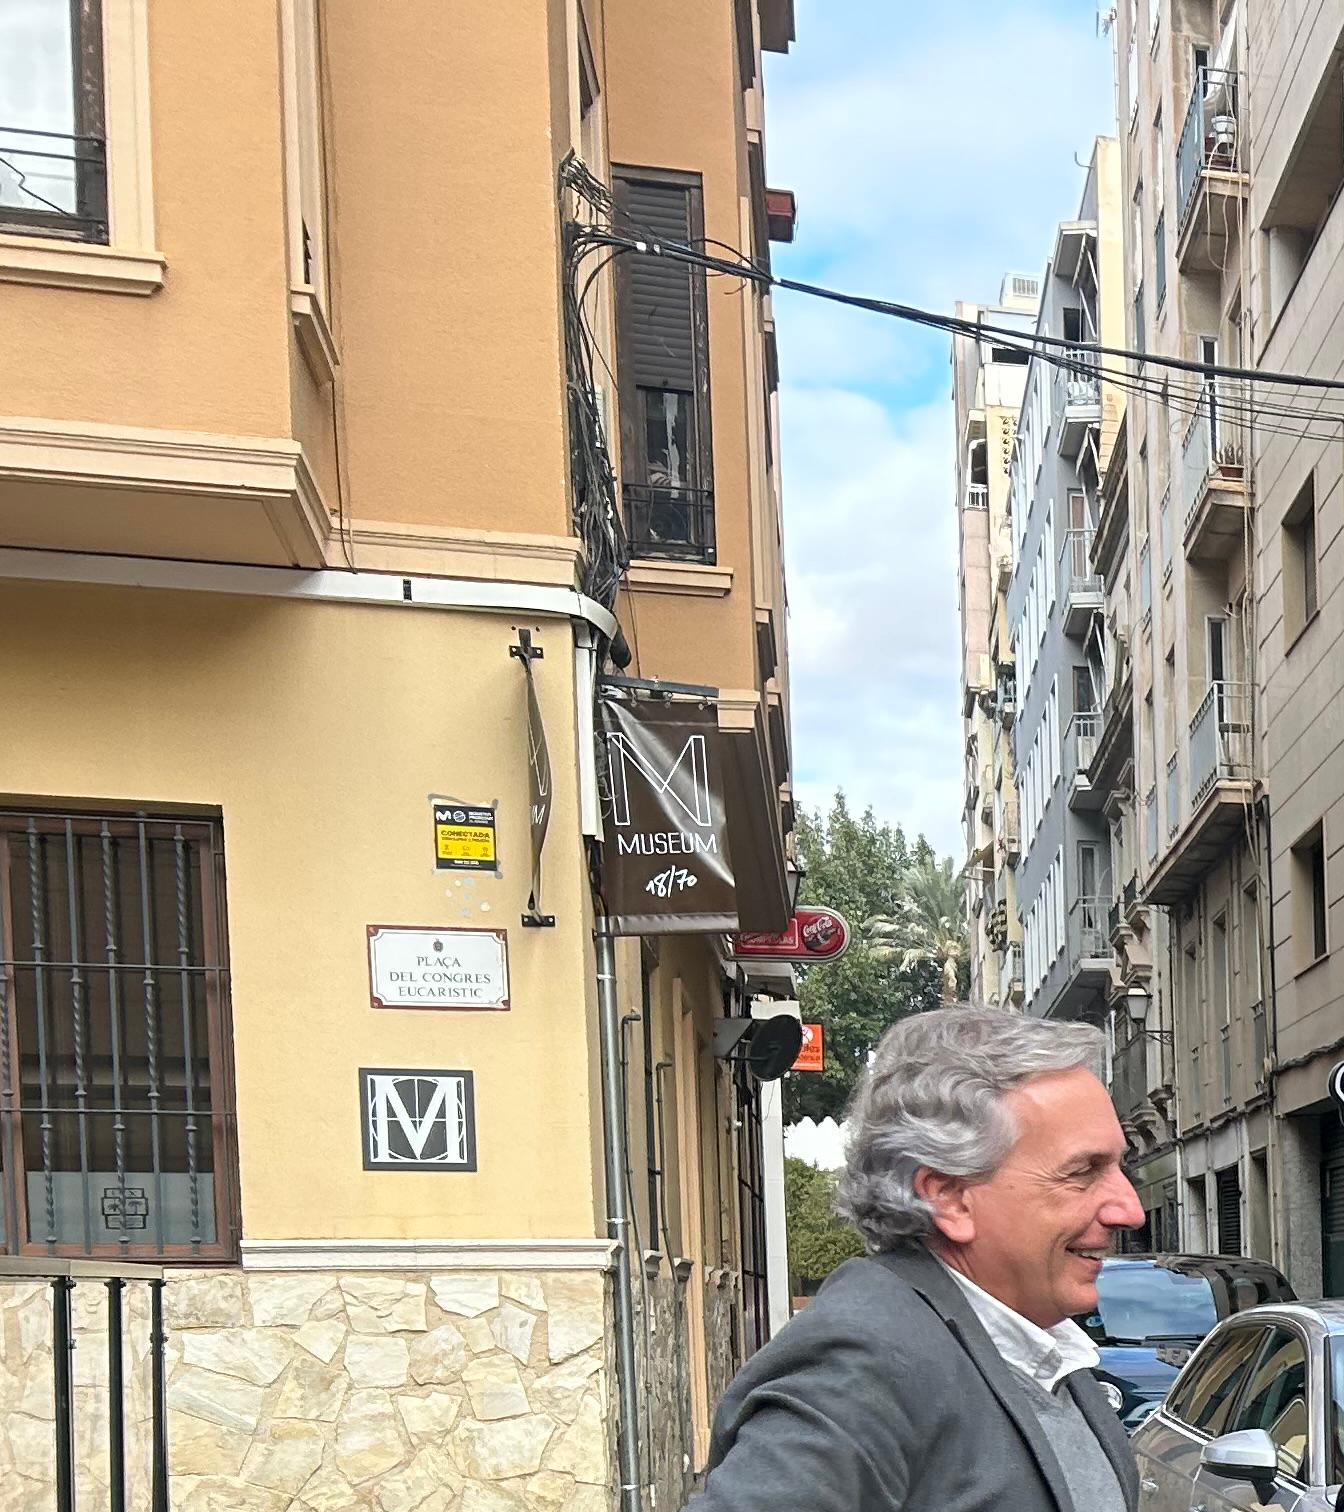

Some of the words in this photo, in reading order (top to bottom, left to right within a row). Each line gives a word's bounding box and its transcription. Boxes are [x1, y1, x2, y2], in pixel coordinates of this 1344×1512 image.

[617, 832, 718, 856] MUSEUM
[416, 956, 461, 969] PLAÇA
[389, 971, 417, 982] DEL
[422, 972, 491, 984] CONGRES
[399, 985, 484, 998] EUCARISTIC
